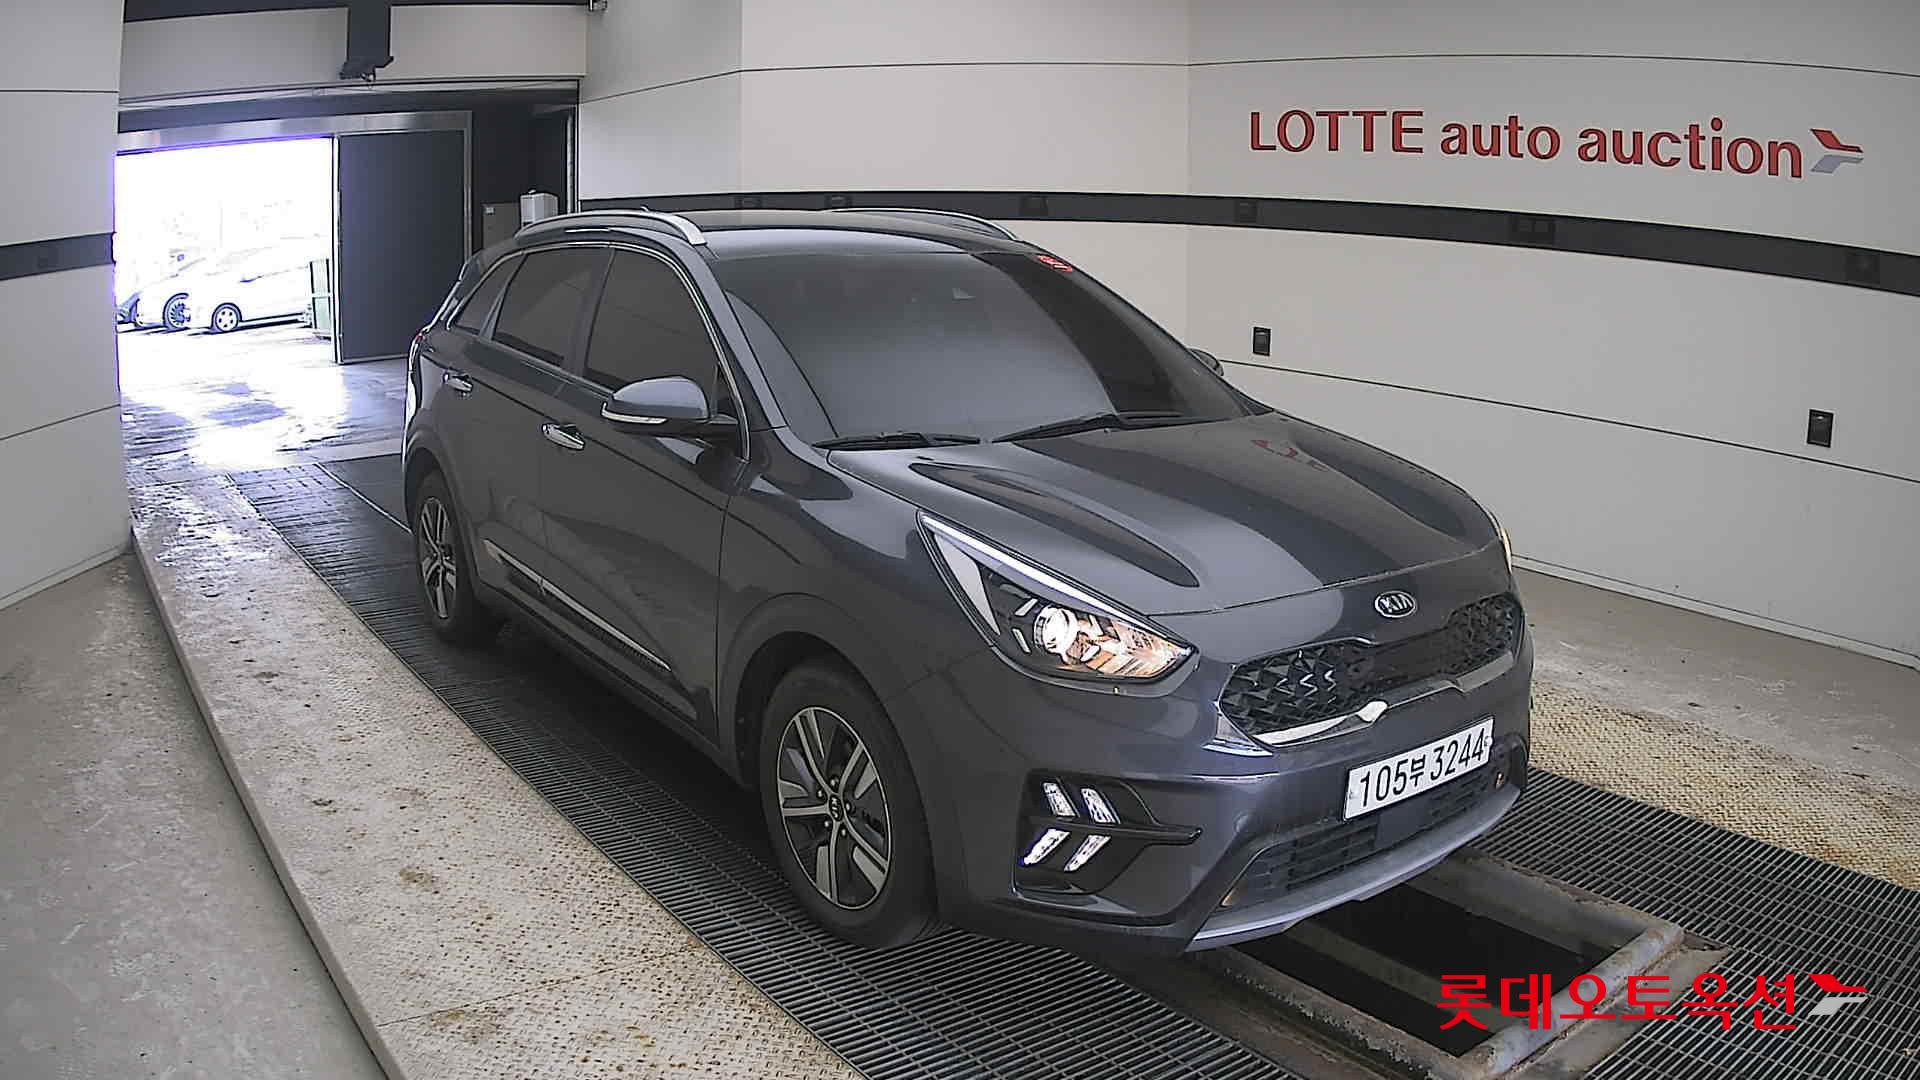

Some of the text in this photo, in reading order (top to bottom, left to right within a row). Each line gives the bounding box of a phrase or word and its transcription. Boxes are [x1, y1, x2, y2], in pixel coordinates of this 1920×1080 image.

[1249, 110, 1803, 179] LOTTE auto auction
[1379, 593, 1413, 614] KIA
